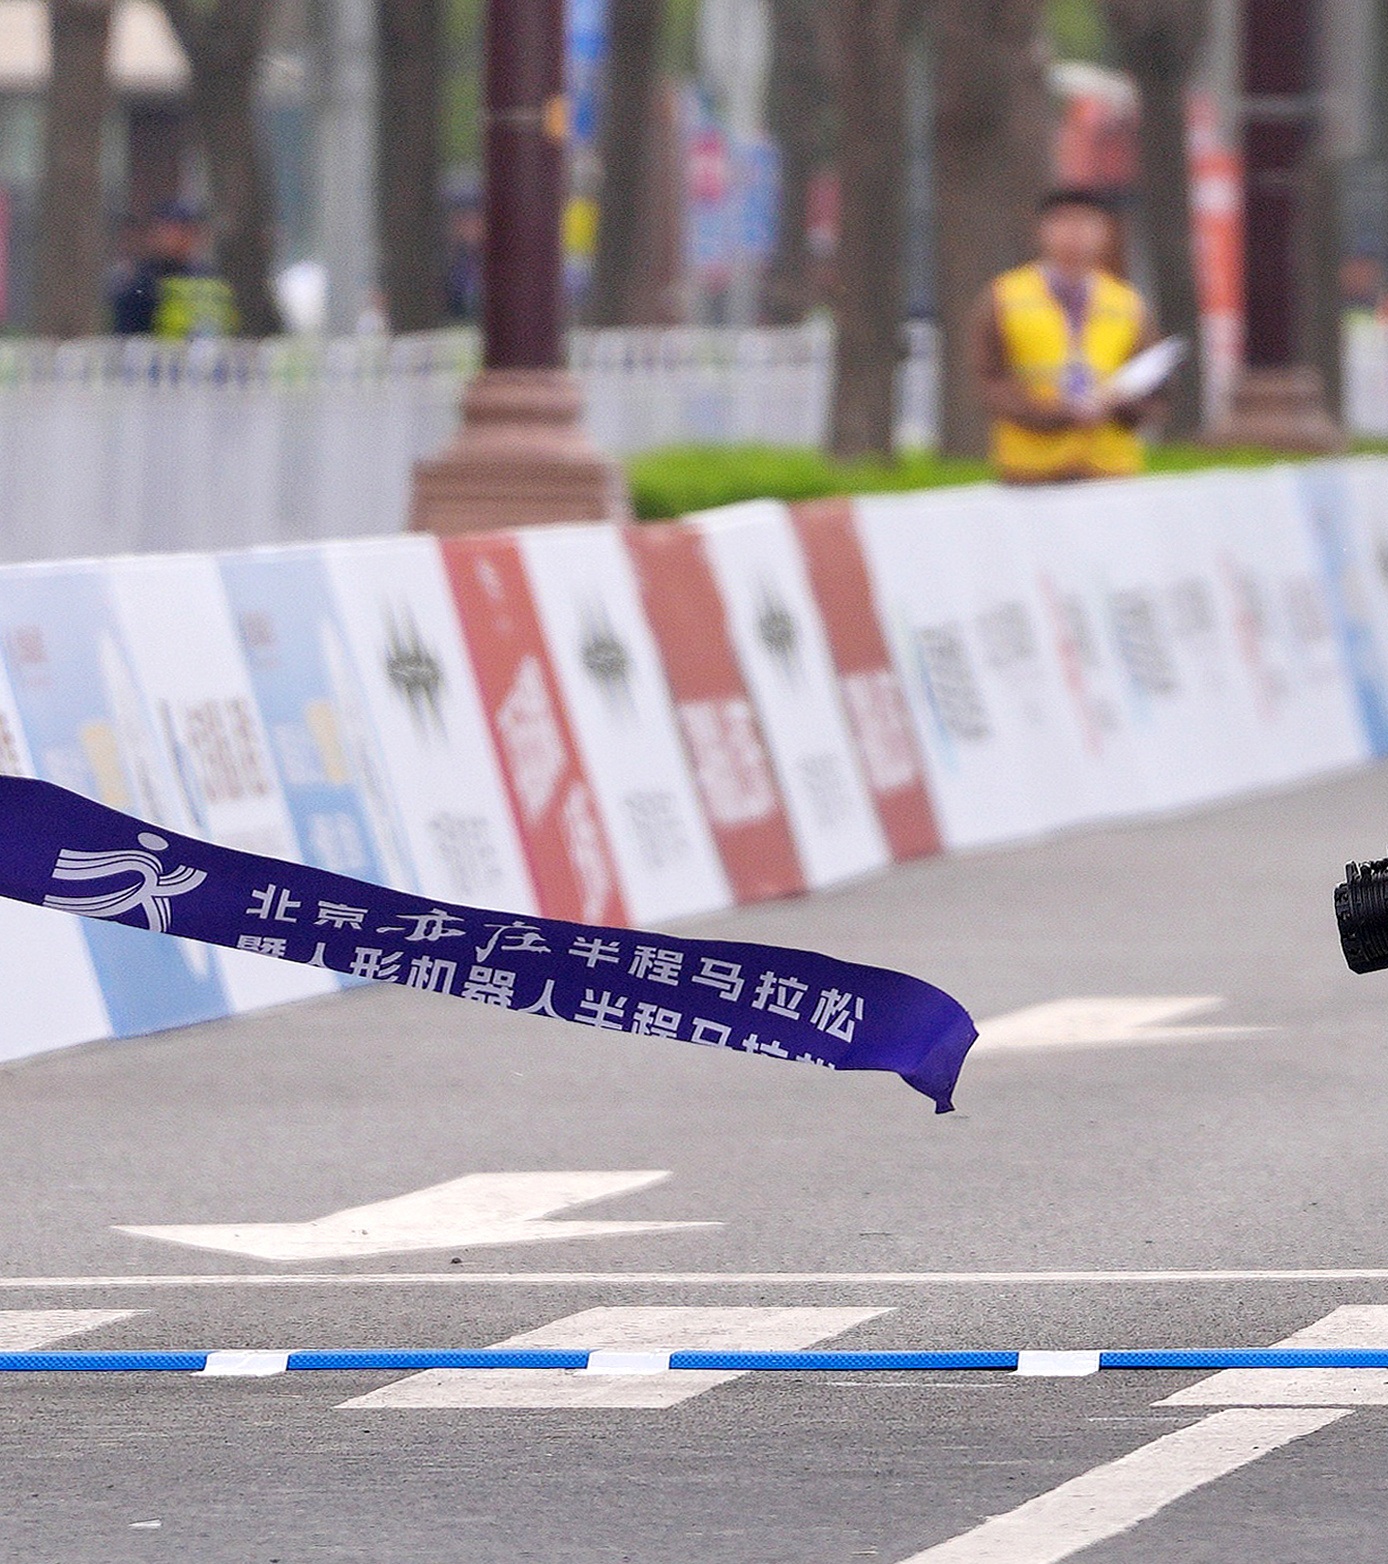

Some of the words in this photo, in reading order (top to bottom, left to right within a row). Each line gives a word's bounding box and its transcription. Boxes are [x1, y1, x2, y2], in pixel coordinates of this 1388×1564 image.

[236, 934, 836, 1070] 暨人形机器人半程马
[246, 884, 864, 1043] 北京亦庄半程马拉松
